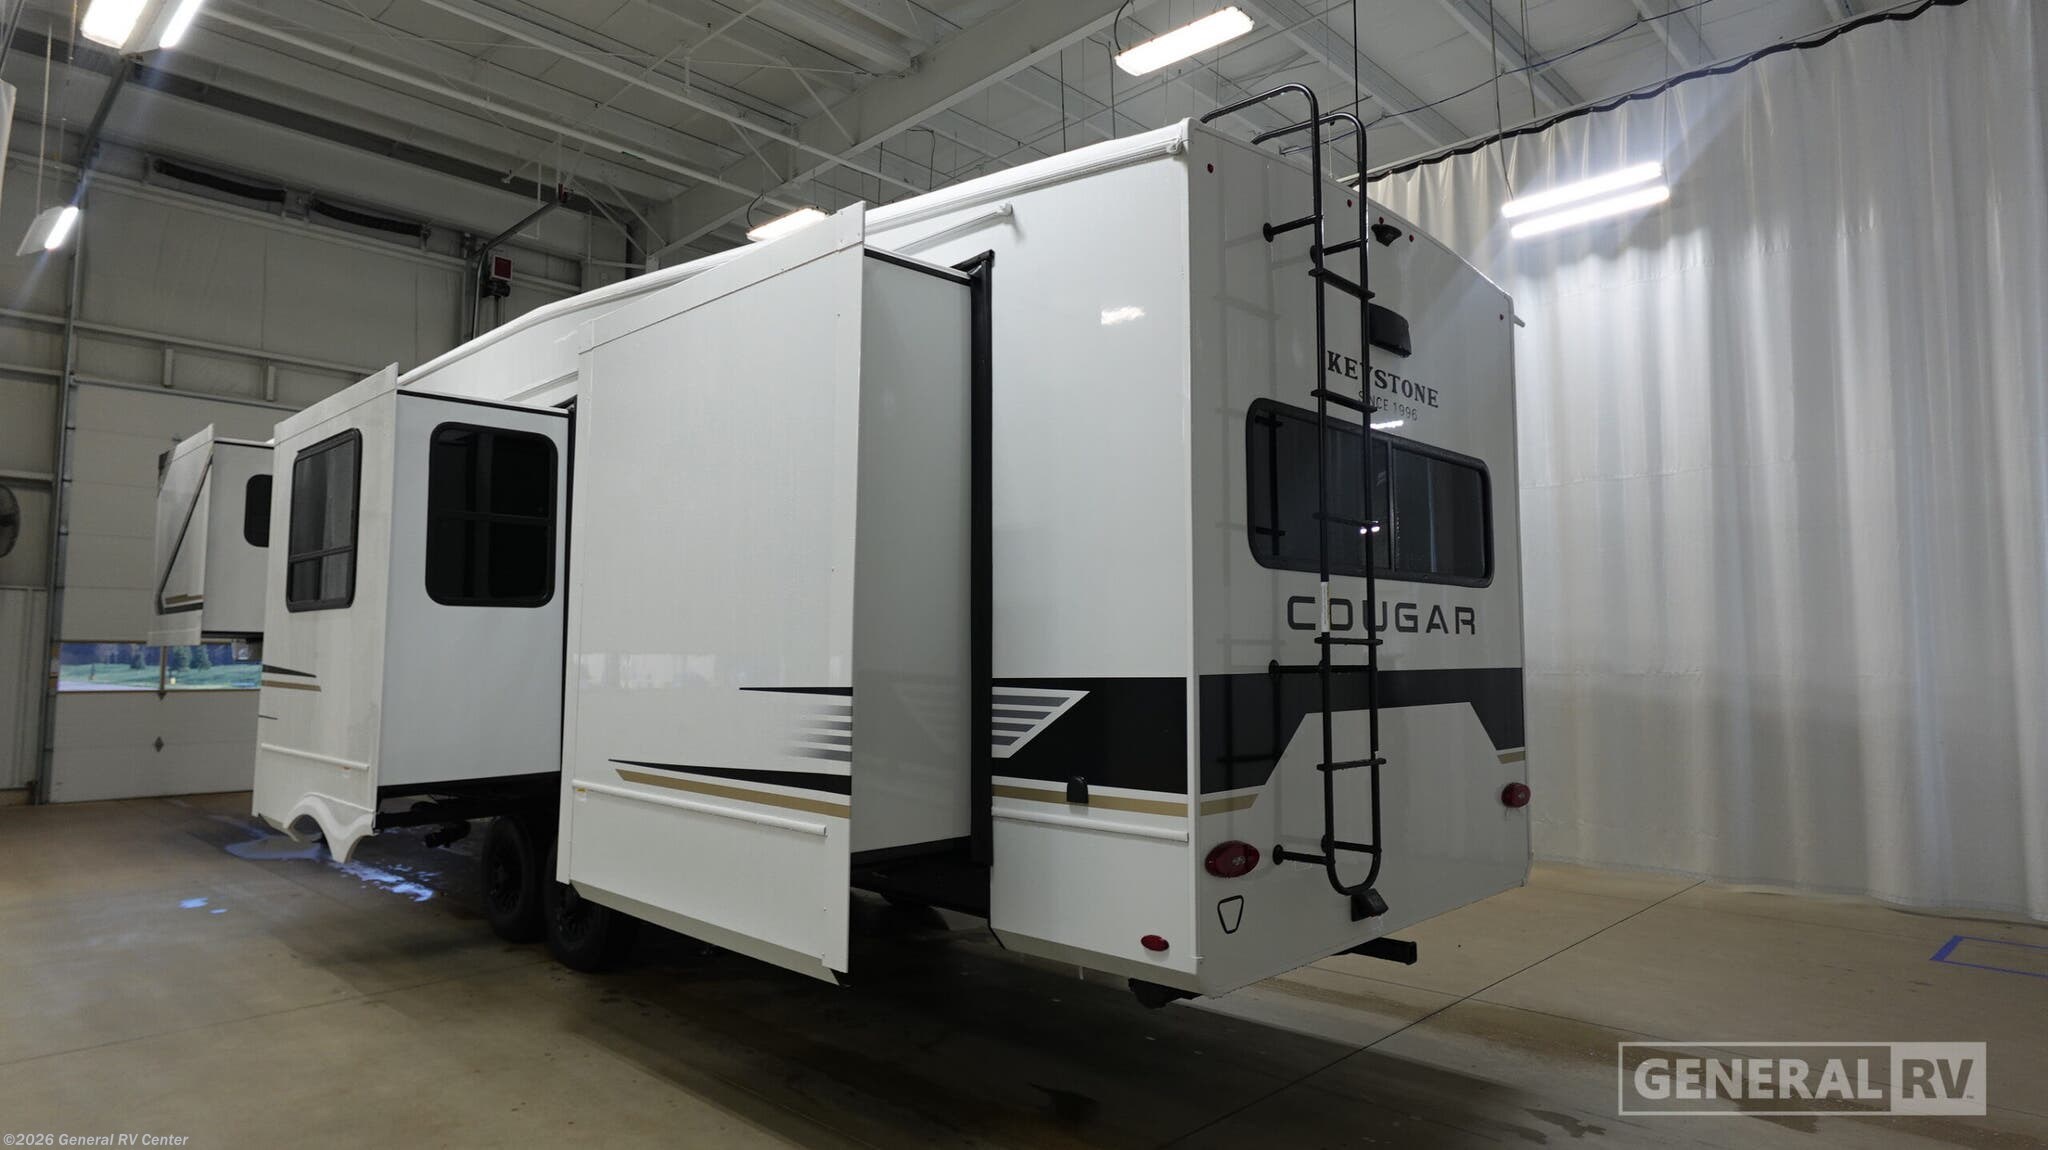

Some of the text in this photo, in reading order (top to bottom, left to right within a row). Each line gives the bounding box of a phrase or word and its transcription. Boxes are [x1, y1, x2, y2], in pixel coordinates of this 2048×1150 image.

[1358, 391, 1418, 421] SNCE 1996
[1287, 595, 1475, 635] COUGAR
